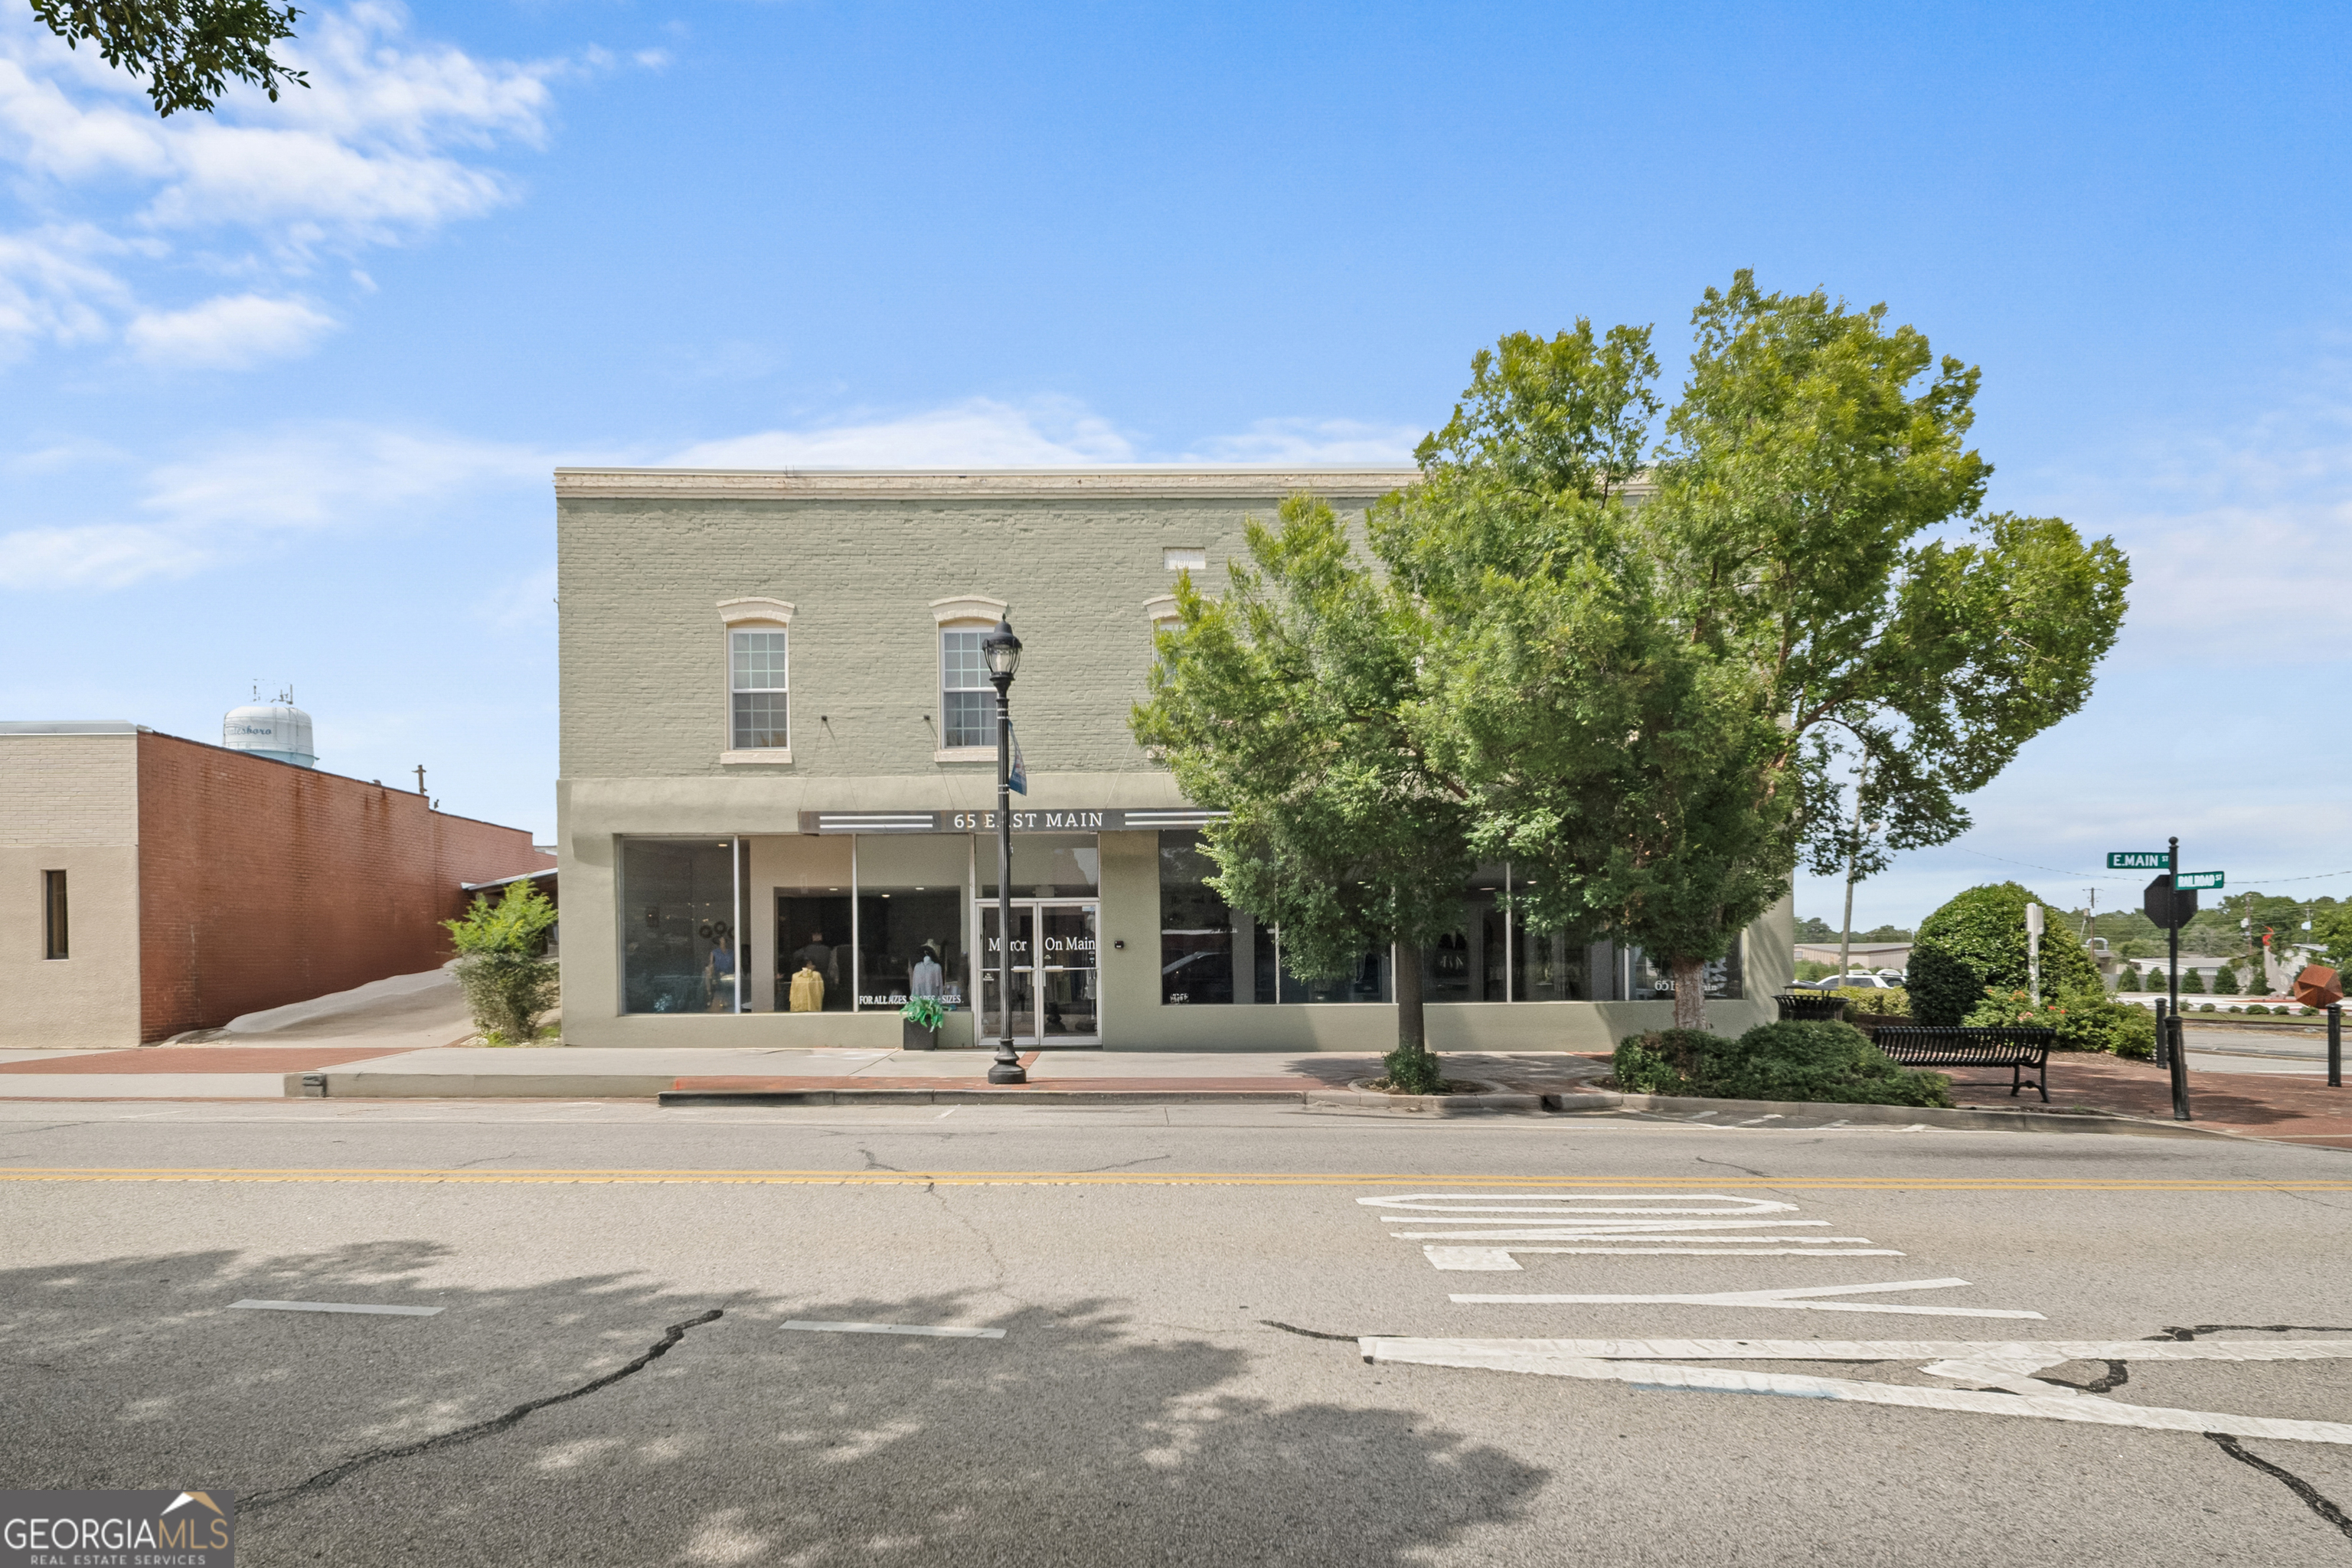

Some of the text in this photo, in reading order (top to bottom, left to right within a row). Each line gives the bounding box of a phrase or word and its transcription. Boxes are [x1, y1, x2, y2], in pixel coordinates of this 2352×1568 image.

[954, 812, 1102, 828] 65 EST MAIN
[2177, 875, 2215, 887] RAILROAD
[988, 936, 1096, 952] Mror On Main
[1655, 980, 1669, 991] 65
[859, 995, 873, 1004] FOR
[874, 995, 888, 1004] ALL
